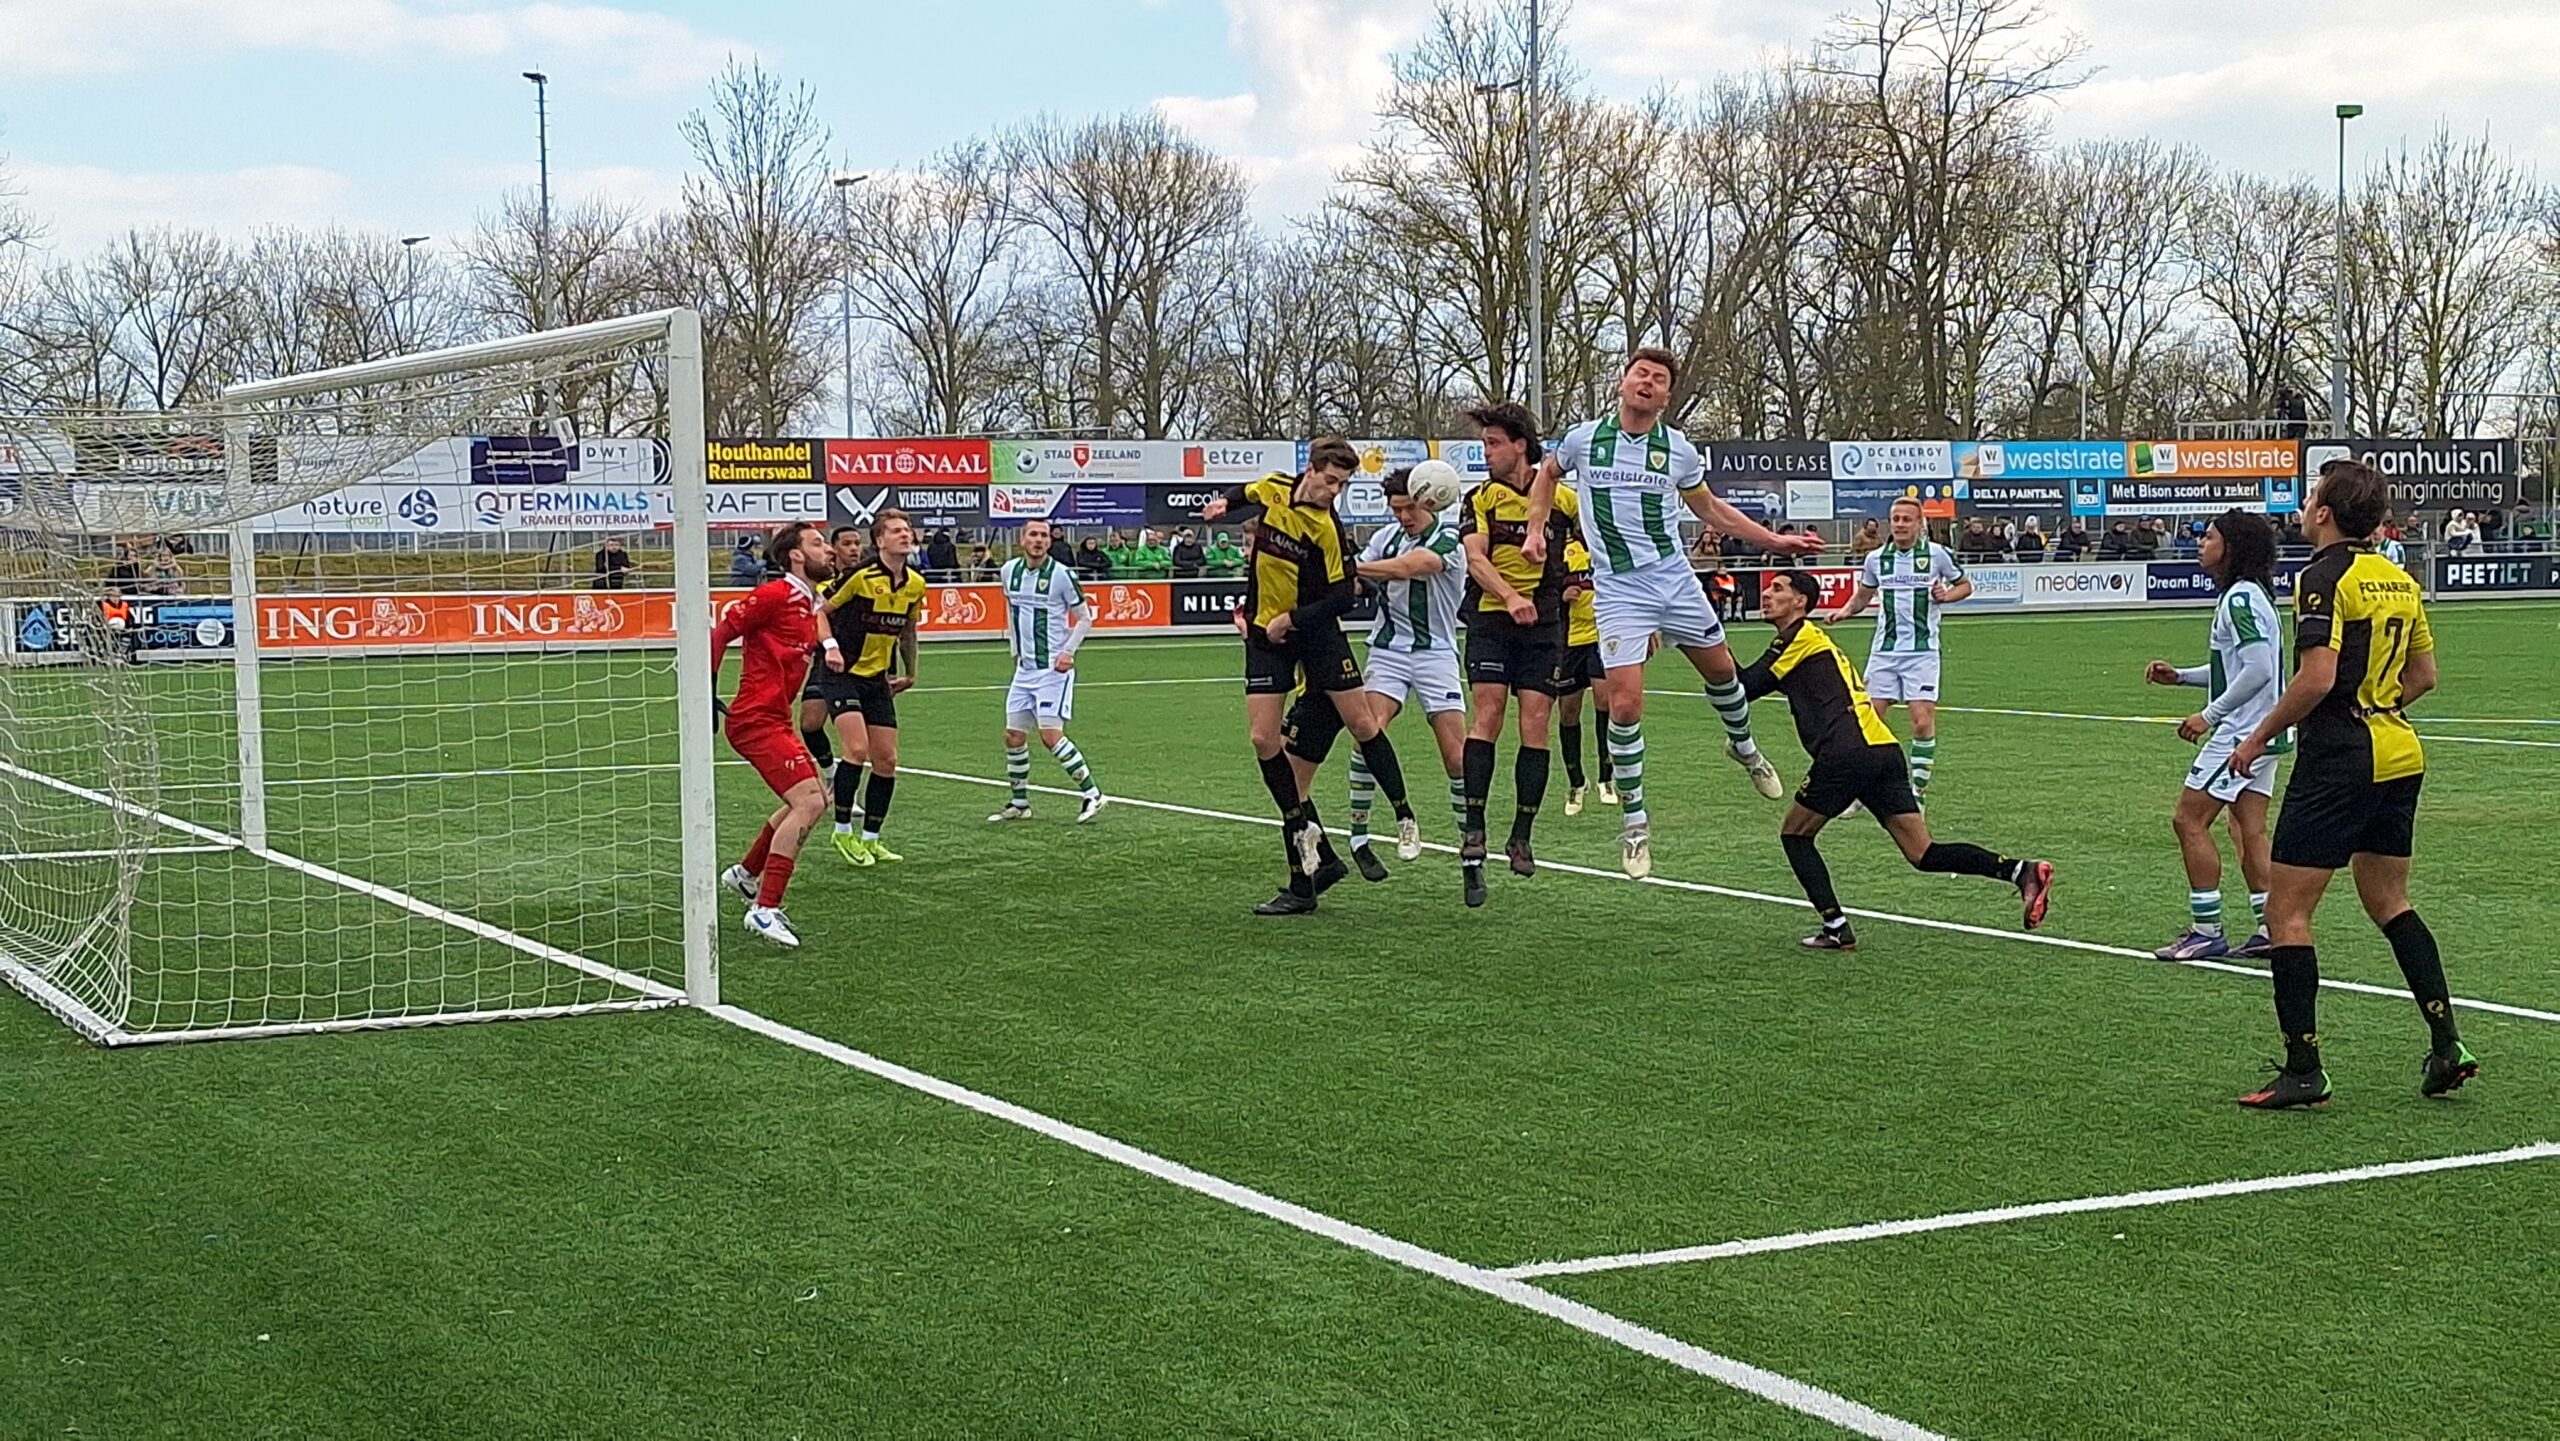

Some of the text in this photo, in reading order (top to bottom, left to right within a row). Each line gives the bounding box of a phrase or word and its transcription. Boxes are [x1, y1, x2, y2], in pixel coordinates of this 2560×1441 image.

[708, 442, 811, 461] Houthandel
[1044, 450, 1072, 460] STAD
[1092, 450, 1141, 460] ZEELAND
[1868, 447, 1942, 457] DC ENERGY
[2007, 447, 2124, 470] weststrate
[2181, 446, 2294, 468] weststrate
[708, 463, 812, 480] Reimerswaal
[831, 453, 987, 474] NATIONAAL
[1721, 455, 1828, 472] AUTOLEASE
[1877, 463, 1936, 473] TRADING
[1589, 468, 1668, 487] weststrate
[1973, 488, 2063, 499] DELTA PAINTS.NL
[2112, 482, 2259, 498] Met Bison scoort u zeker!
[2388, 480, 2504, 505] ninginrichting
[303, 496, 382, 515] nature
[521, 514, 650, 526] KRAMER ROTTERDAM
[1970, 571, 2018, 584] NJURIAM
[2035, 571, 2134, 596] medenvoy
[2148, 572, 2215, 590] Dream Big,
[1973, 582, 2019, 592] XPERTISE
[265, 606, 361, 641] ING
[471, 603, 561, 636] ING
[2377, 617, 2404, 688] 7
